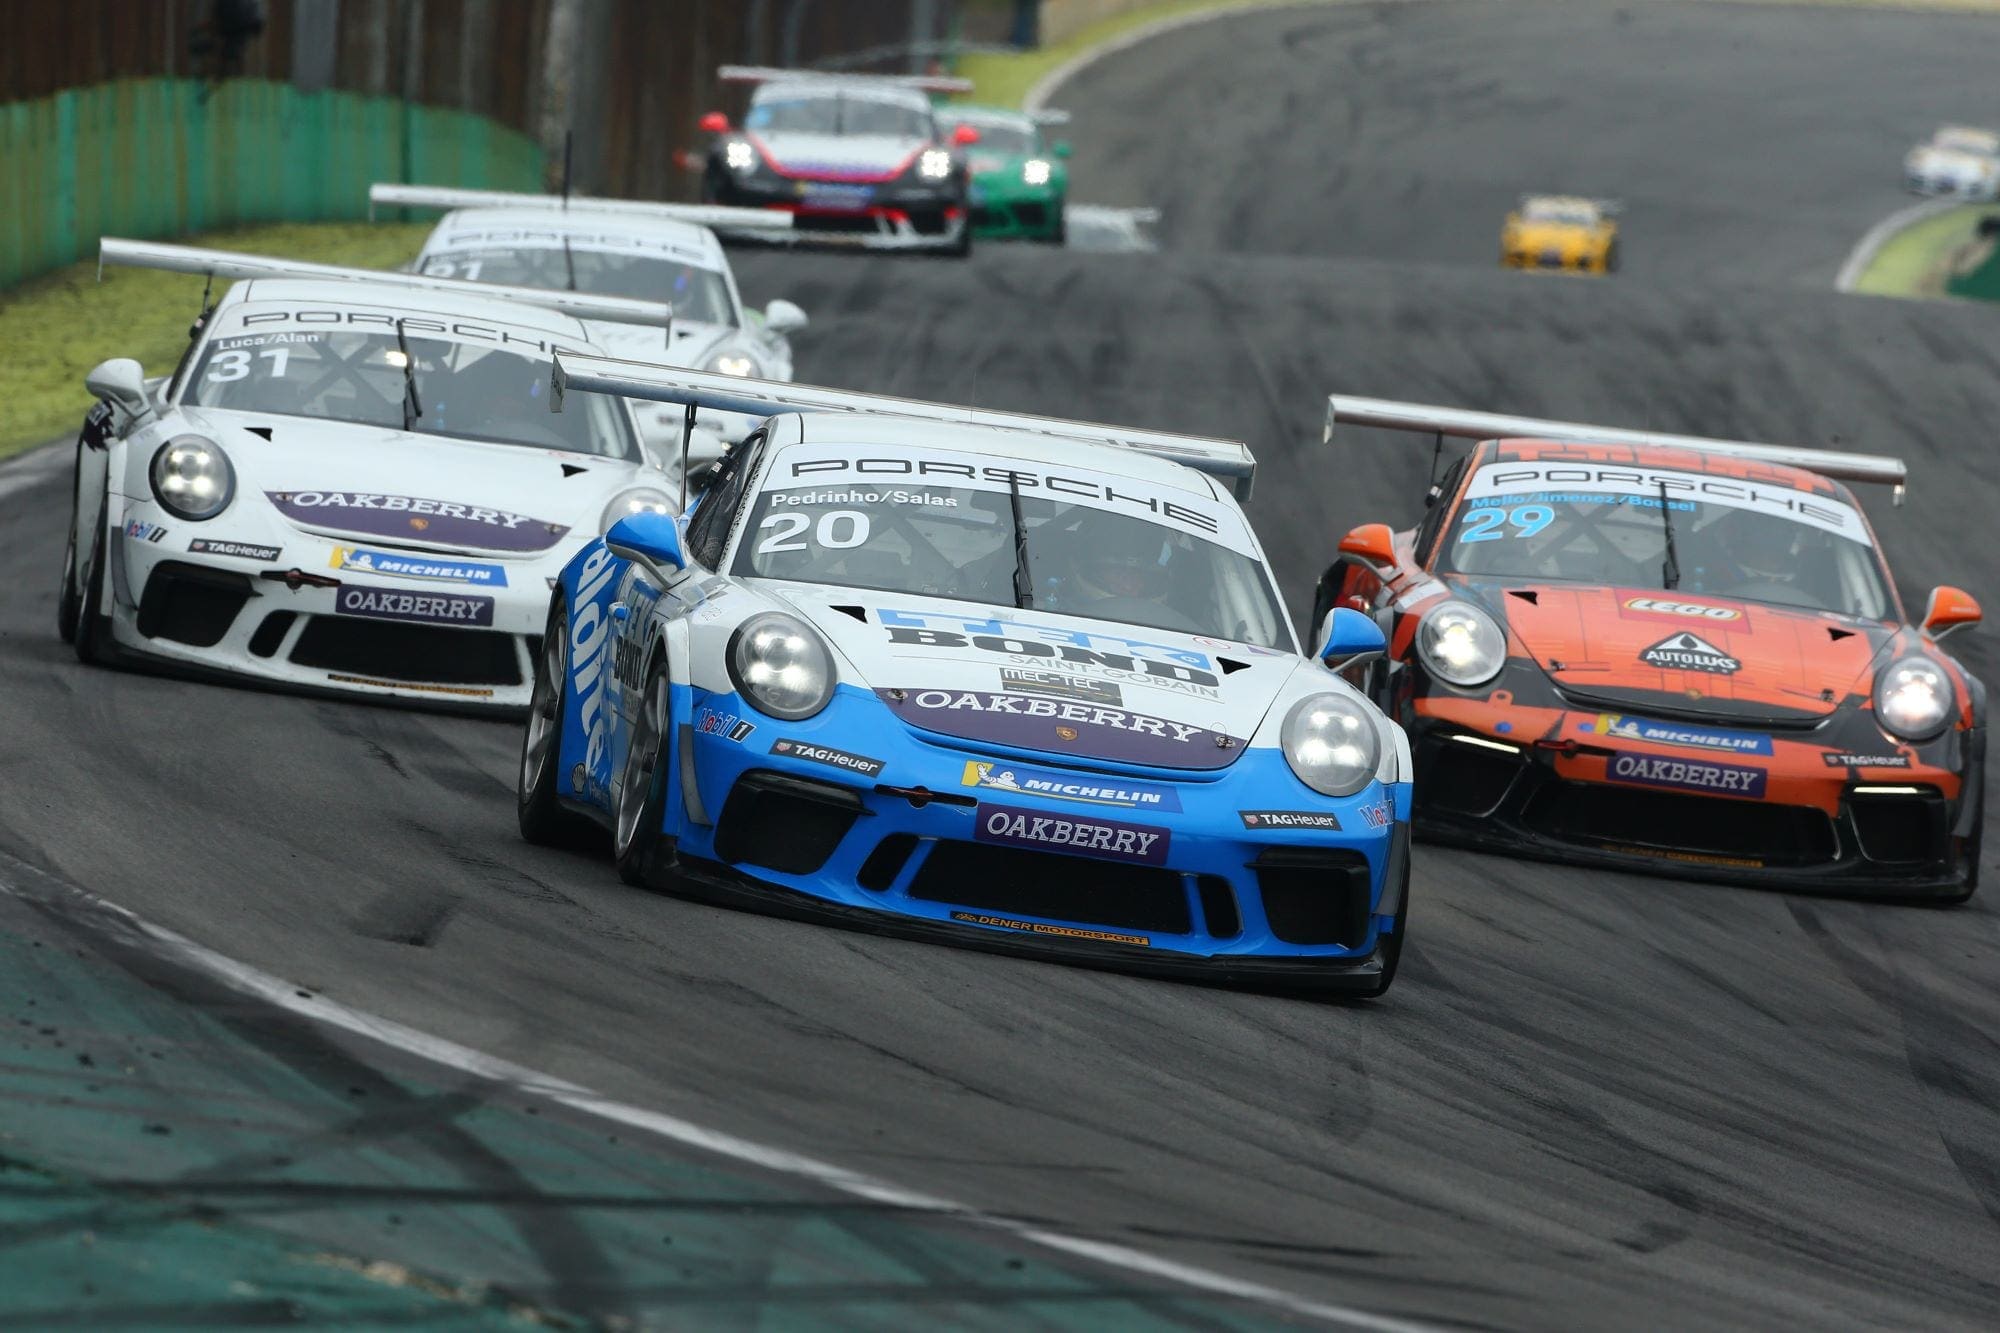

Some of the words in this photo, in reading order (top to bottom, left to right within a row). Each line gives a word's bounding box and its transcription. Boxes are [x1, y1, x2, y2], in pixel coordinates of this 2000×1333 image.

[218, 332, 319, 350] Luca/Alan
[243, 311, 580, 355] PORSCH
[207, 347, 290, 384] 31
[292, 492, 530, 529] OAKBERRY
[771, 490, 958, 508] Pedrinho/Salas
[791, 459, 1218, 535] PORSCHE
[1493, 470, 1845, 528] PORSCHE
[758, 510, 870, 554] 20
[1460, 504, 1555, 544] 29
[379, 560, 491, 580] MICHELIN
[345, 591, 485, 620] OAKBERRY
[1629, 598, 1737, 619] LEGO
[884, 627, 1220, 687] BOND
[1003, 668, 1101, 690] MEC-TEC
[1008, 654, 1219, 698] SAINT-GOBAIN
[695, 708, 737, 737] Mobil
[915, 691, 1203, 743] OAKBERRY
[1646, 727, 1759, 749] MICHELIN
[1024, 779, 1162, 804] MICHELIN
[1615, 757, 1759, 791] OAKBERRY
[986, 812, 1160, 856] OAKBERRY
[978, 916, 1032, 931] DENER
[1036, 925, 1146, 944] MOTORSPORT
